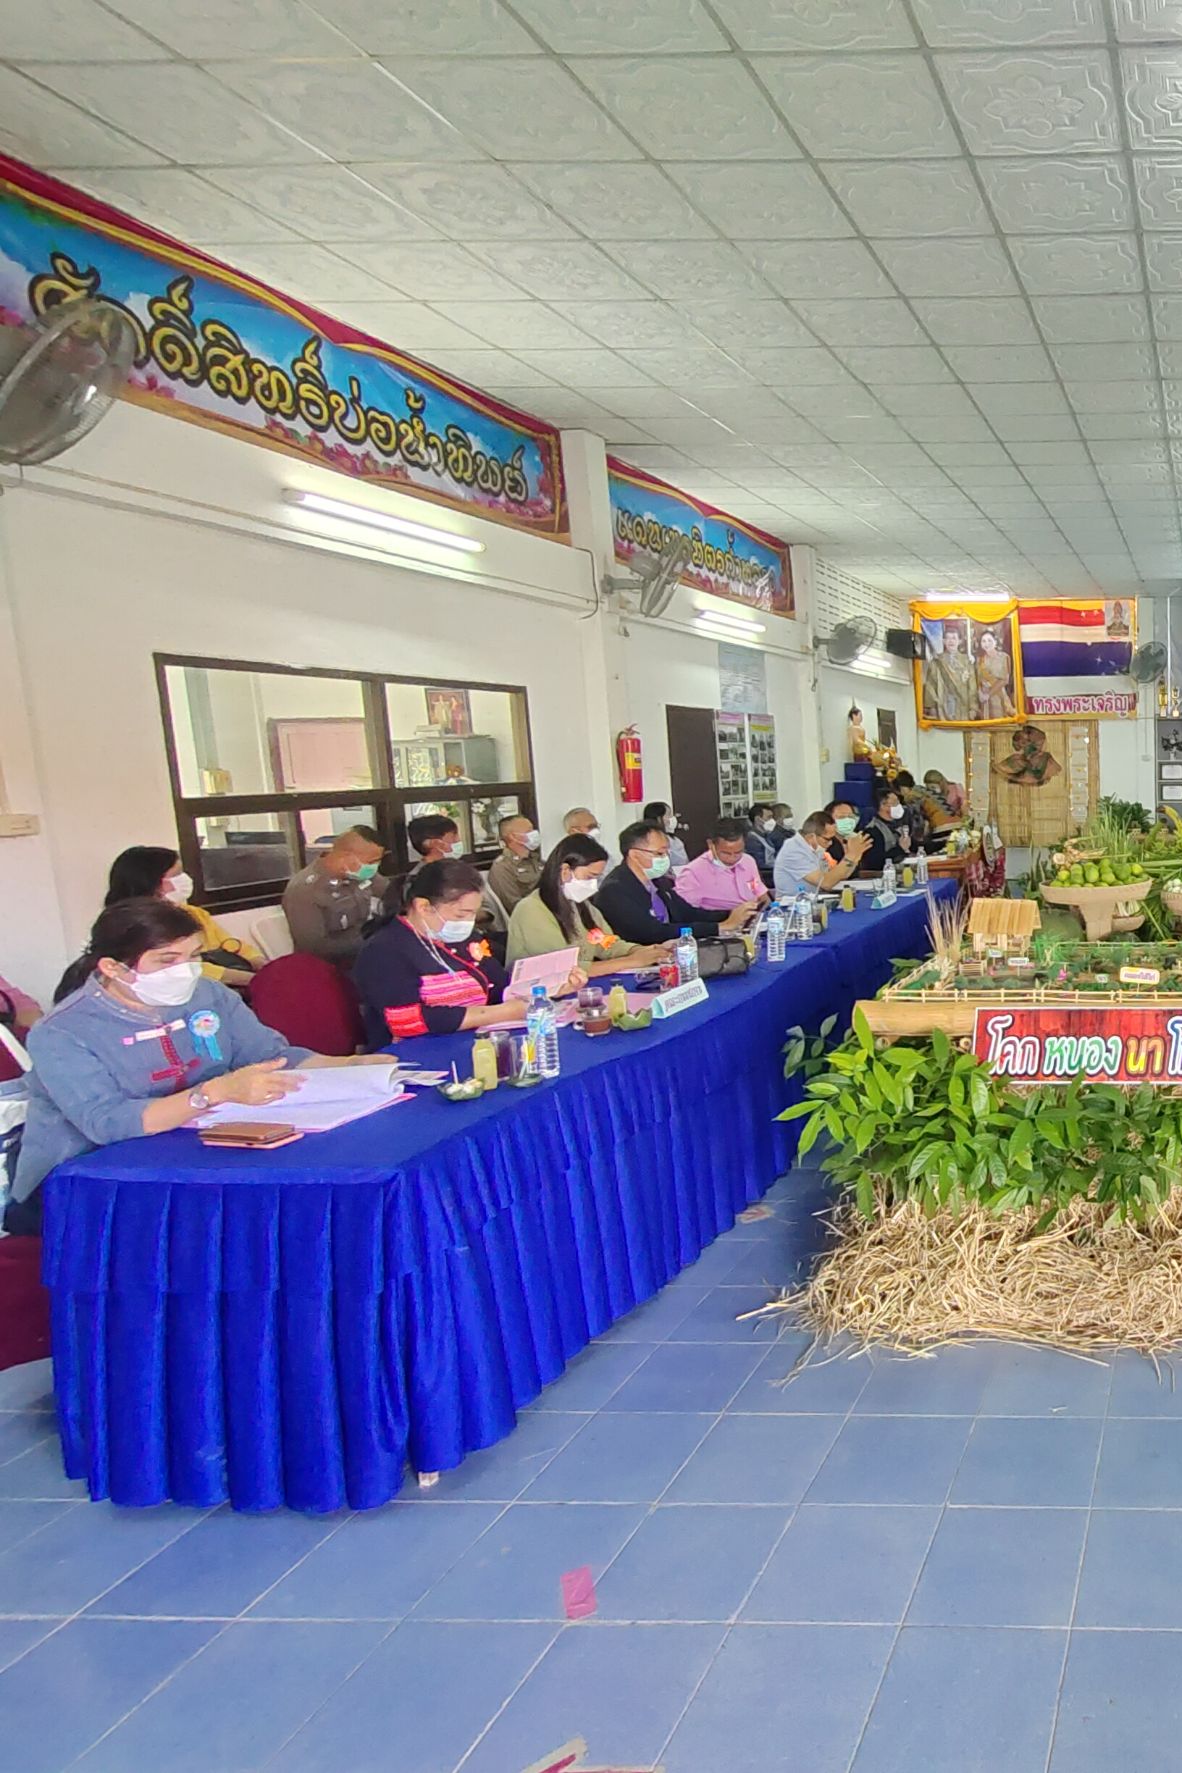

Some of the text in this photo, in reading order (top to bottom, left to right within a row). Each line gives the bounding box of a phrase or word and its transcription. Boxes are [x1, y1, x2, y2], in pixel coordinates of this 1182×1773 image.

[1033, 689, 1128, 718] ทรงพระเจริญ
[987, 1014, 1039, 1076] โคก
[1041, 1035, 1122, 1076] หนอง
[1125, 1035, 1165, 1074] นา
